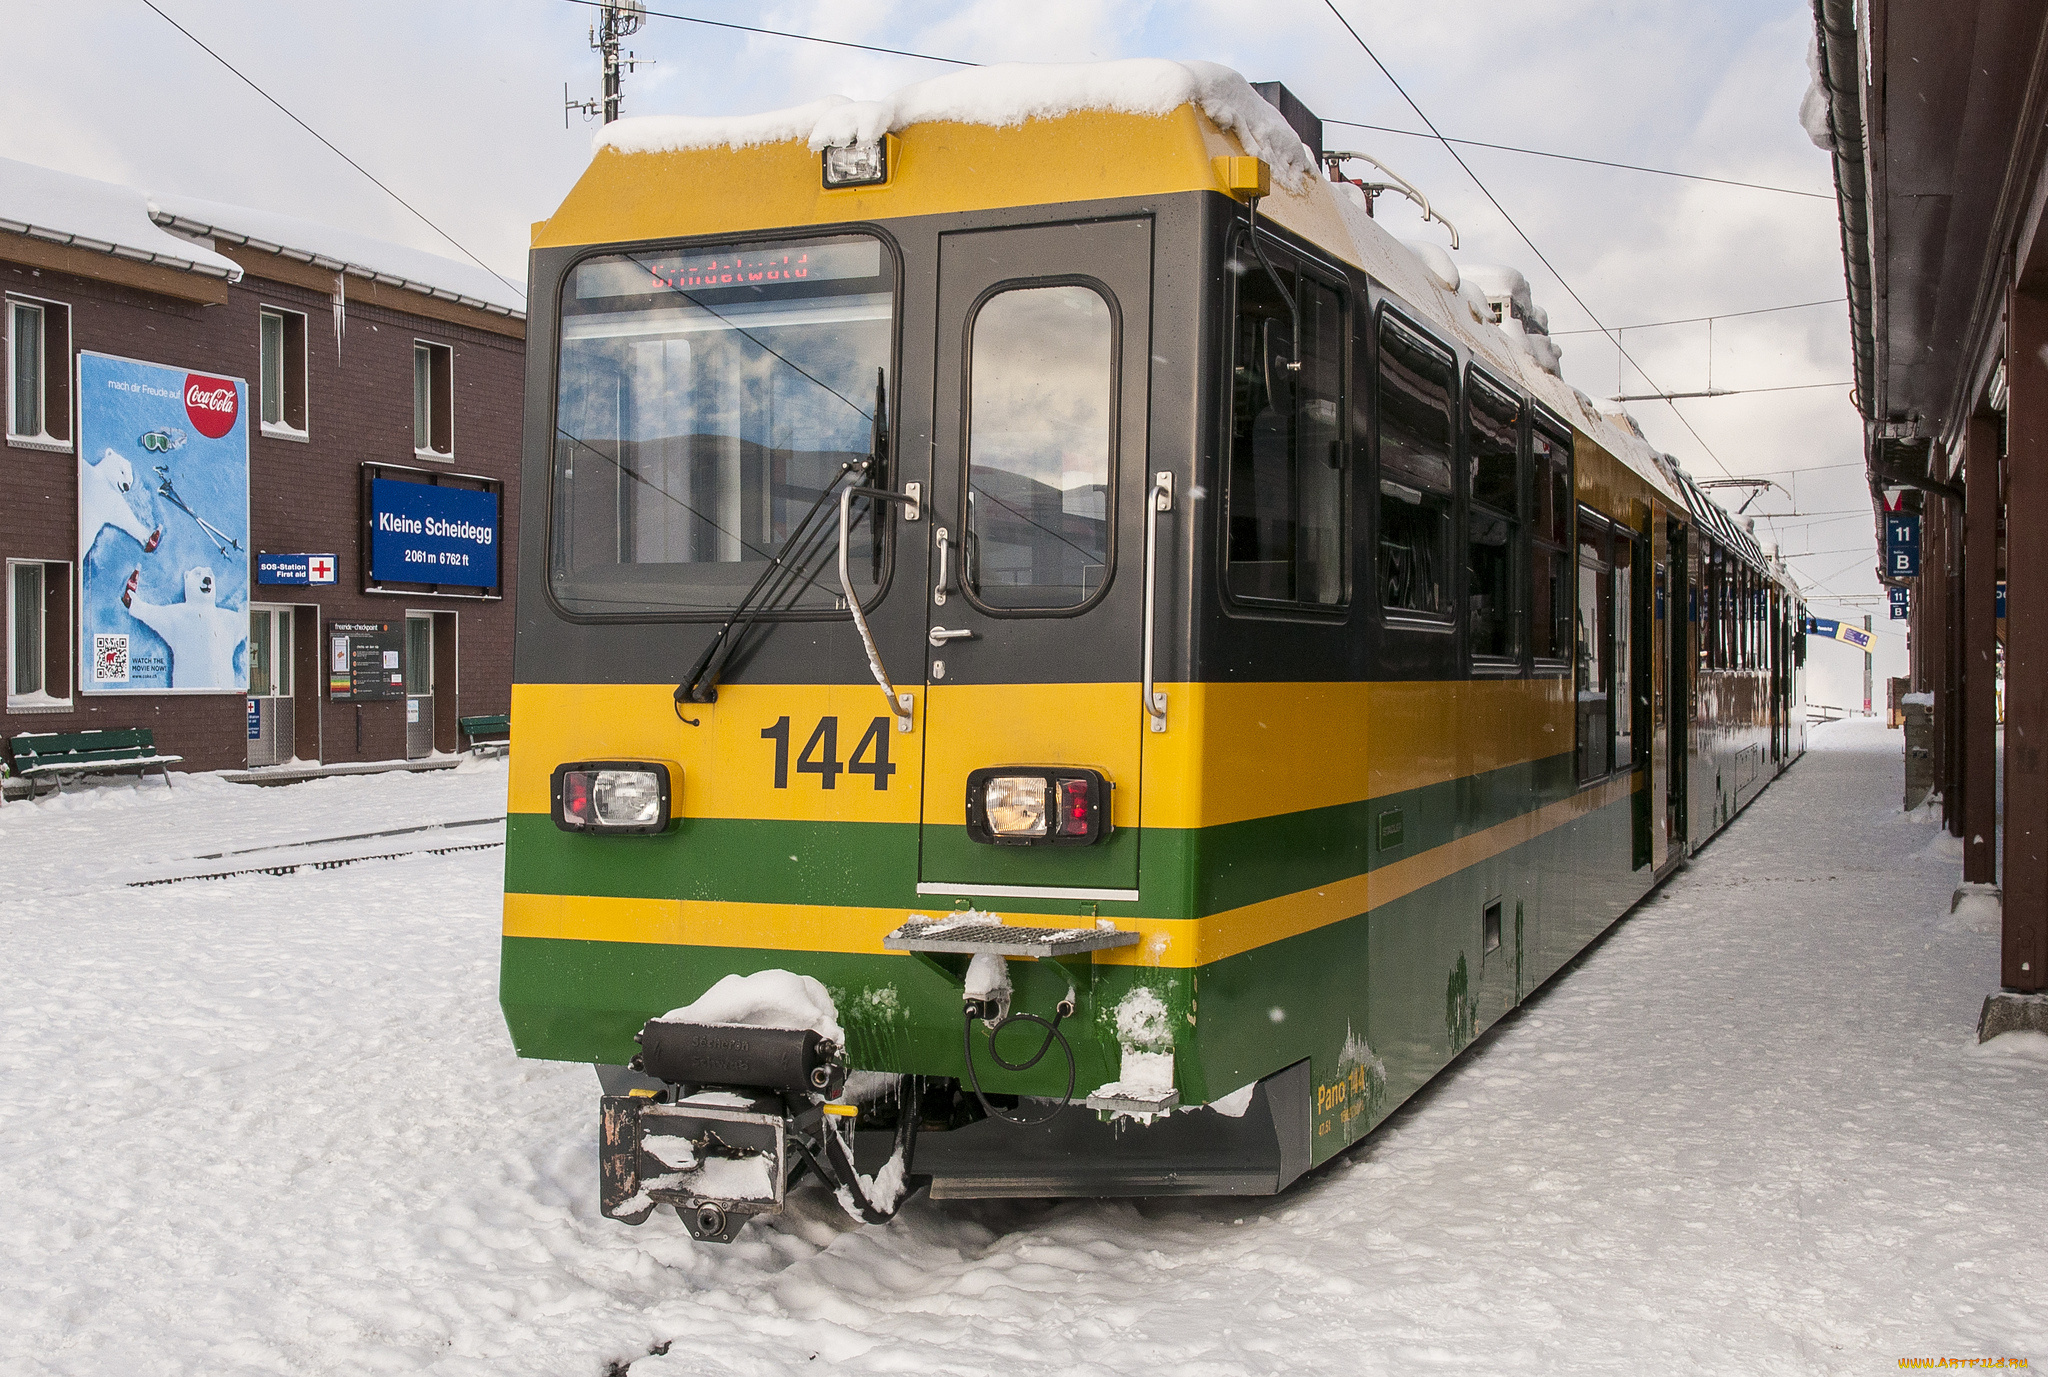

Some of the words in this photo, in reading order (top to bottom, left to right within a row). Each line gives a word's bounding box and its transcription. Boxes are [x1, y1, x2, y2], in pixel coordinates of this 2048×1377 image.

[108, 380, 130, 392] mach
[130, 383, 141, 393] dir
[142, 384, 168, 398] Freude
[169, 389, 182, 399] auf
[186, 384, 236, 414] Coca-Cola
[379, 511, 423, 535] Kleine
[425, 516, 493, 545] Scheidegg
[1895, 526, 1910, 542] 11
[260, 563, 306, 571] SOS-Station
[427, 553, 437, 564] m
[462, 554, 470, 567] ft
[1896, 554, 1910, 570] B
[1894, 592, 1903, 601] 11
[1894, 607, 1903, 616] B
[760, 716, 896, 791] 144
[1318, 1081, 1346, 1115] Pano
